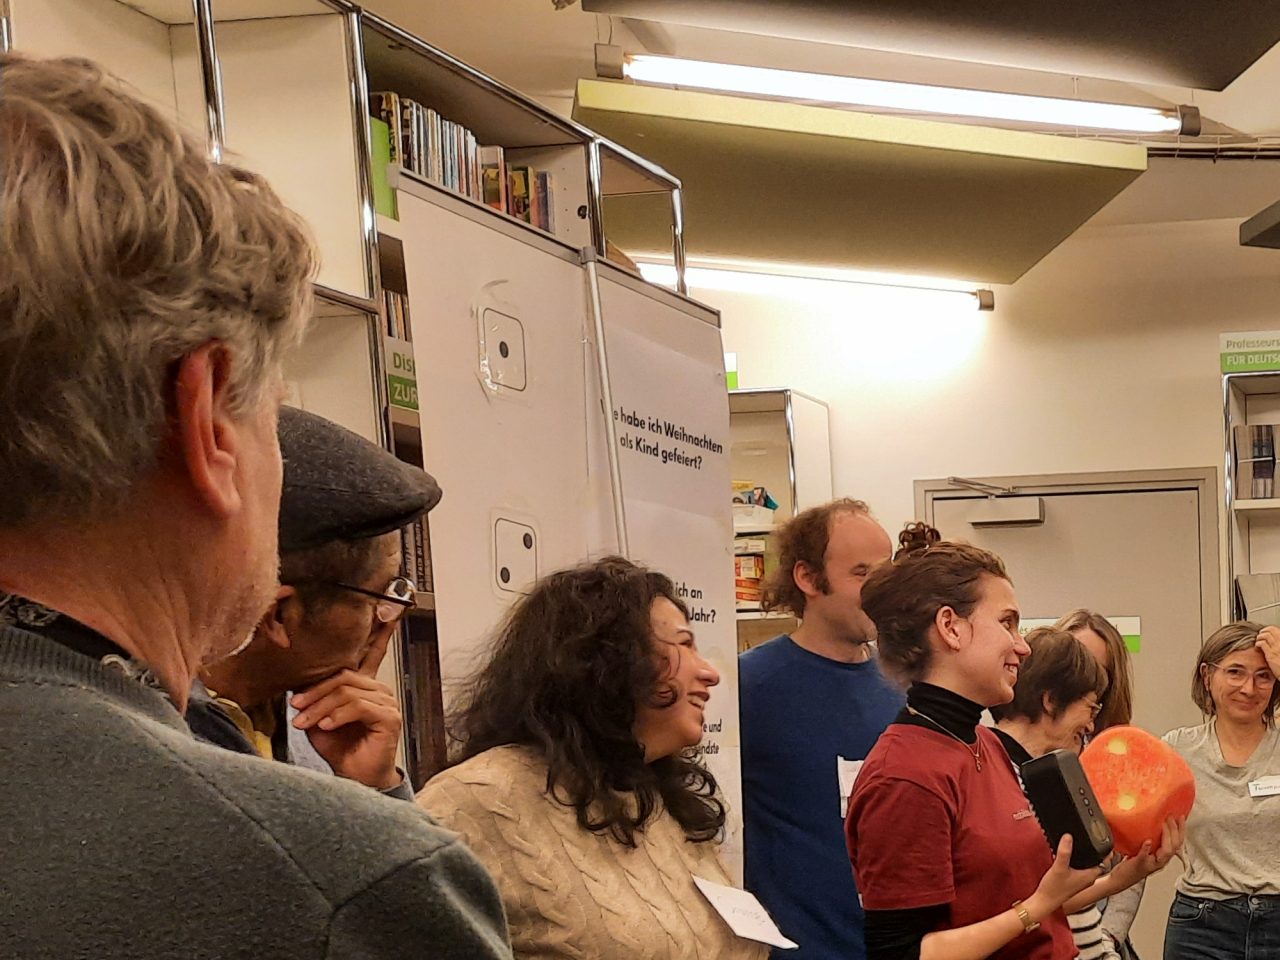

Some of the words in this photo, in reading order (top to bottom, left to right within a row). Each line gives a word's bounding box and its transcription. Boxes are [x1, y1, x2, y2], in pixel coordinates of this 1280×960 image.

[1226, 339, 1280, 349] Professeurs
[1226, 354, 1246, 366] FÜR
[620, 406, 646, 430] habe
[648, 416, 663, 435] ich
[663, 420, 723, 454] Weihnachten
[620, 432, 634, 450] als
[635, 435, 659, 458] Kind
[661, 447, 703, 470] gefeiert?
[675, 581, 688, 598] ich
[690, 588, 703, 600] an
[690, 606, 717, 624] Jahr?
[708, 718, 723, 733] und
